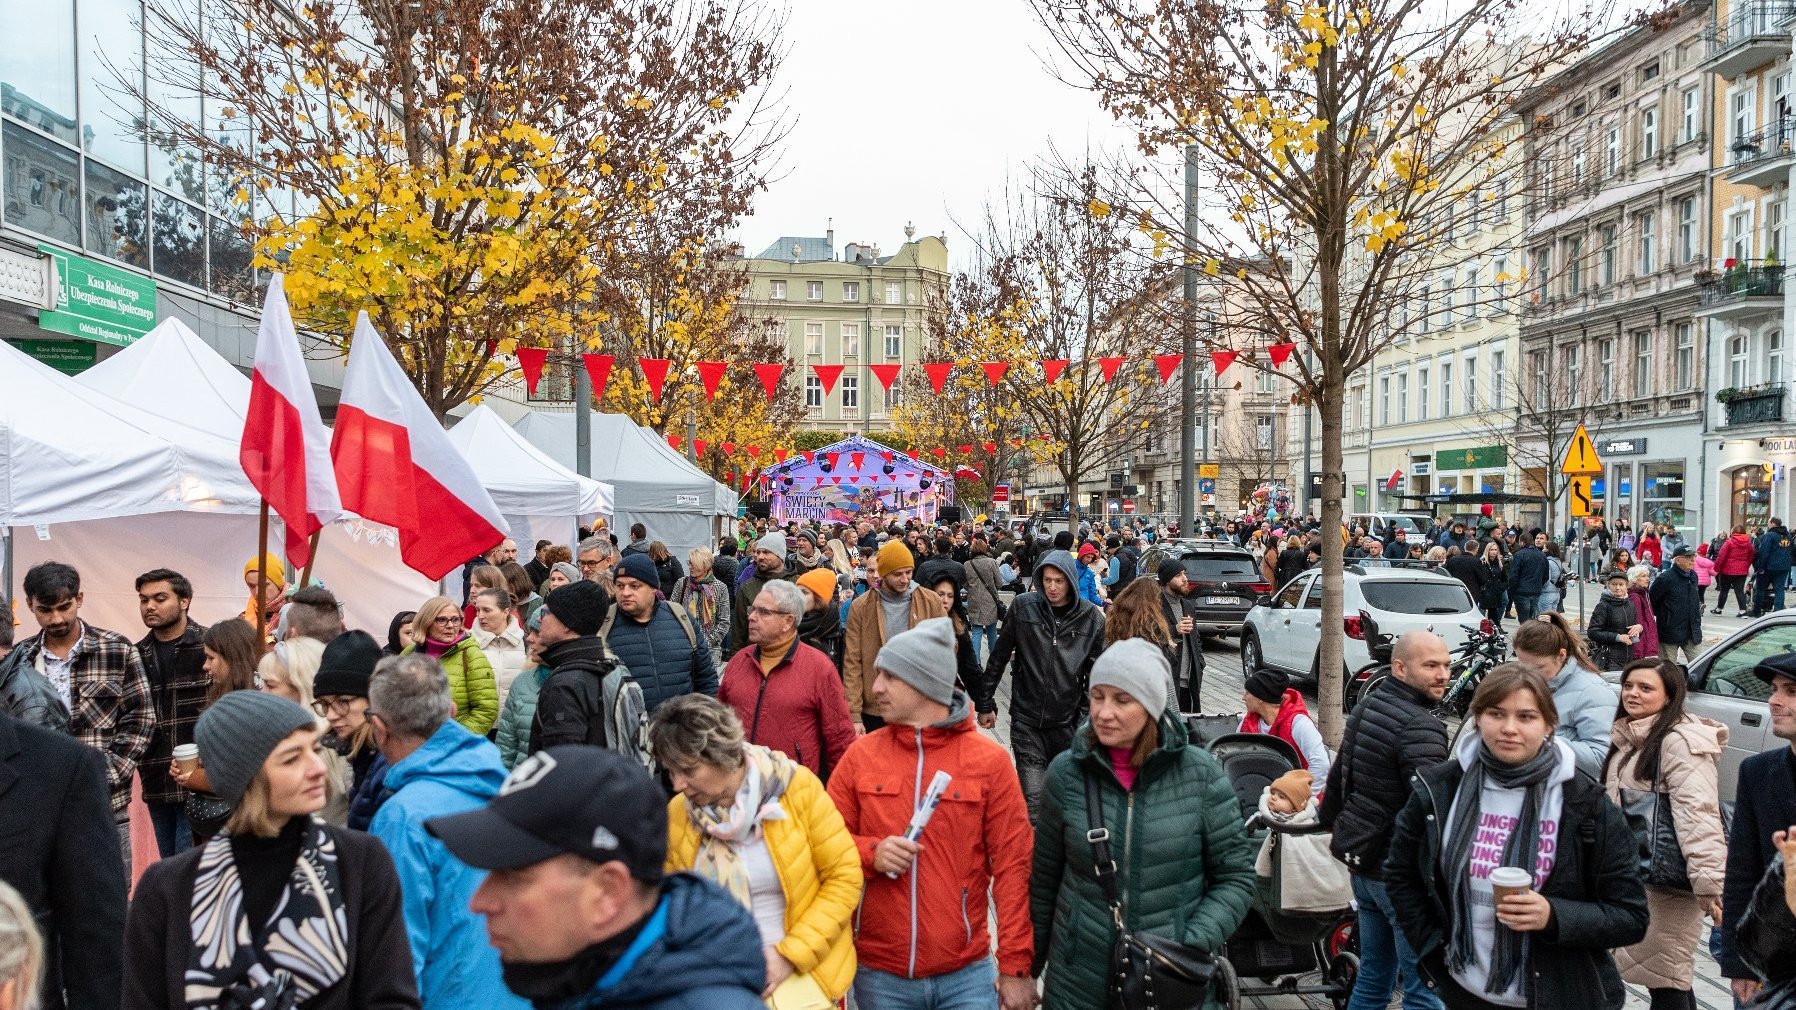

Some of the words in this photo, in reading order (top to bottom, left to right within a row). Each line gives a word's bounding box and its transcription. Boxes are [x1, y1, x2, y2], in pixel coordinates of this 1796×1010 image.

[70, 286, 118, 310] Ubezpieczenia
[87, 274, 105, 290] Kasa
[105, 280, 139, 301] Rolniczego
[785, 508, 826, 519] MARCIN
